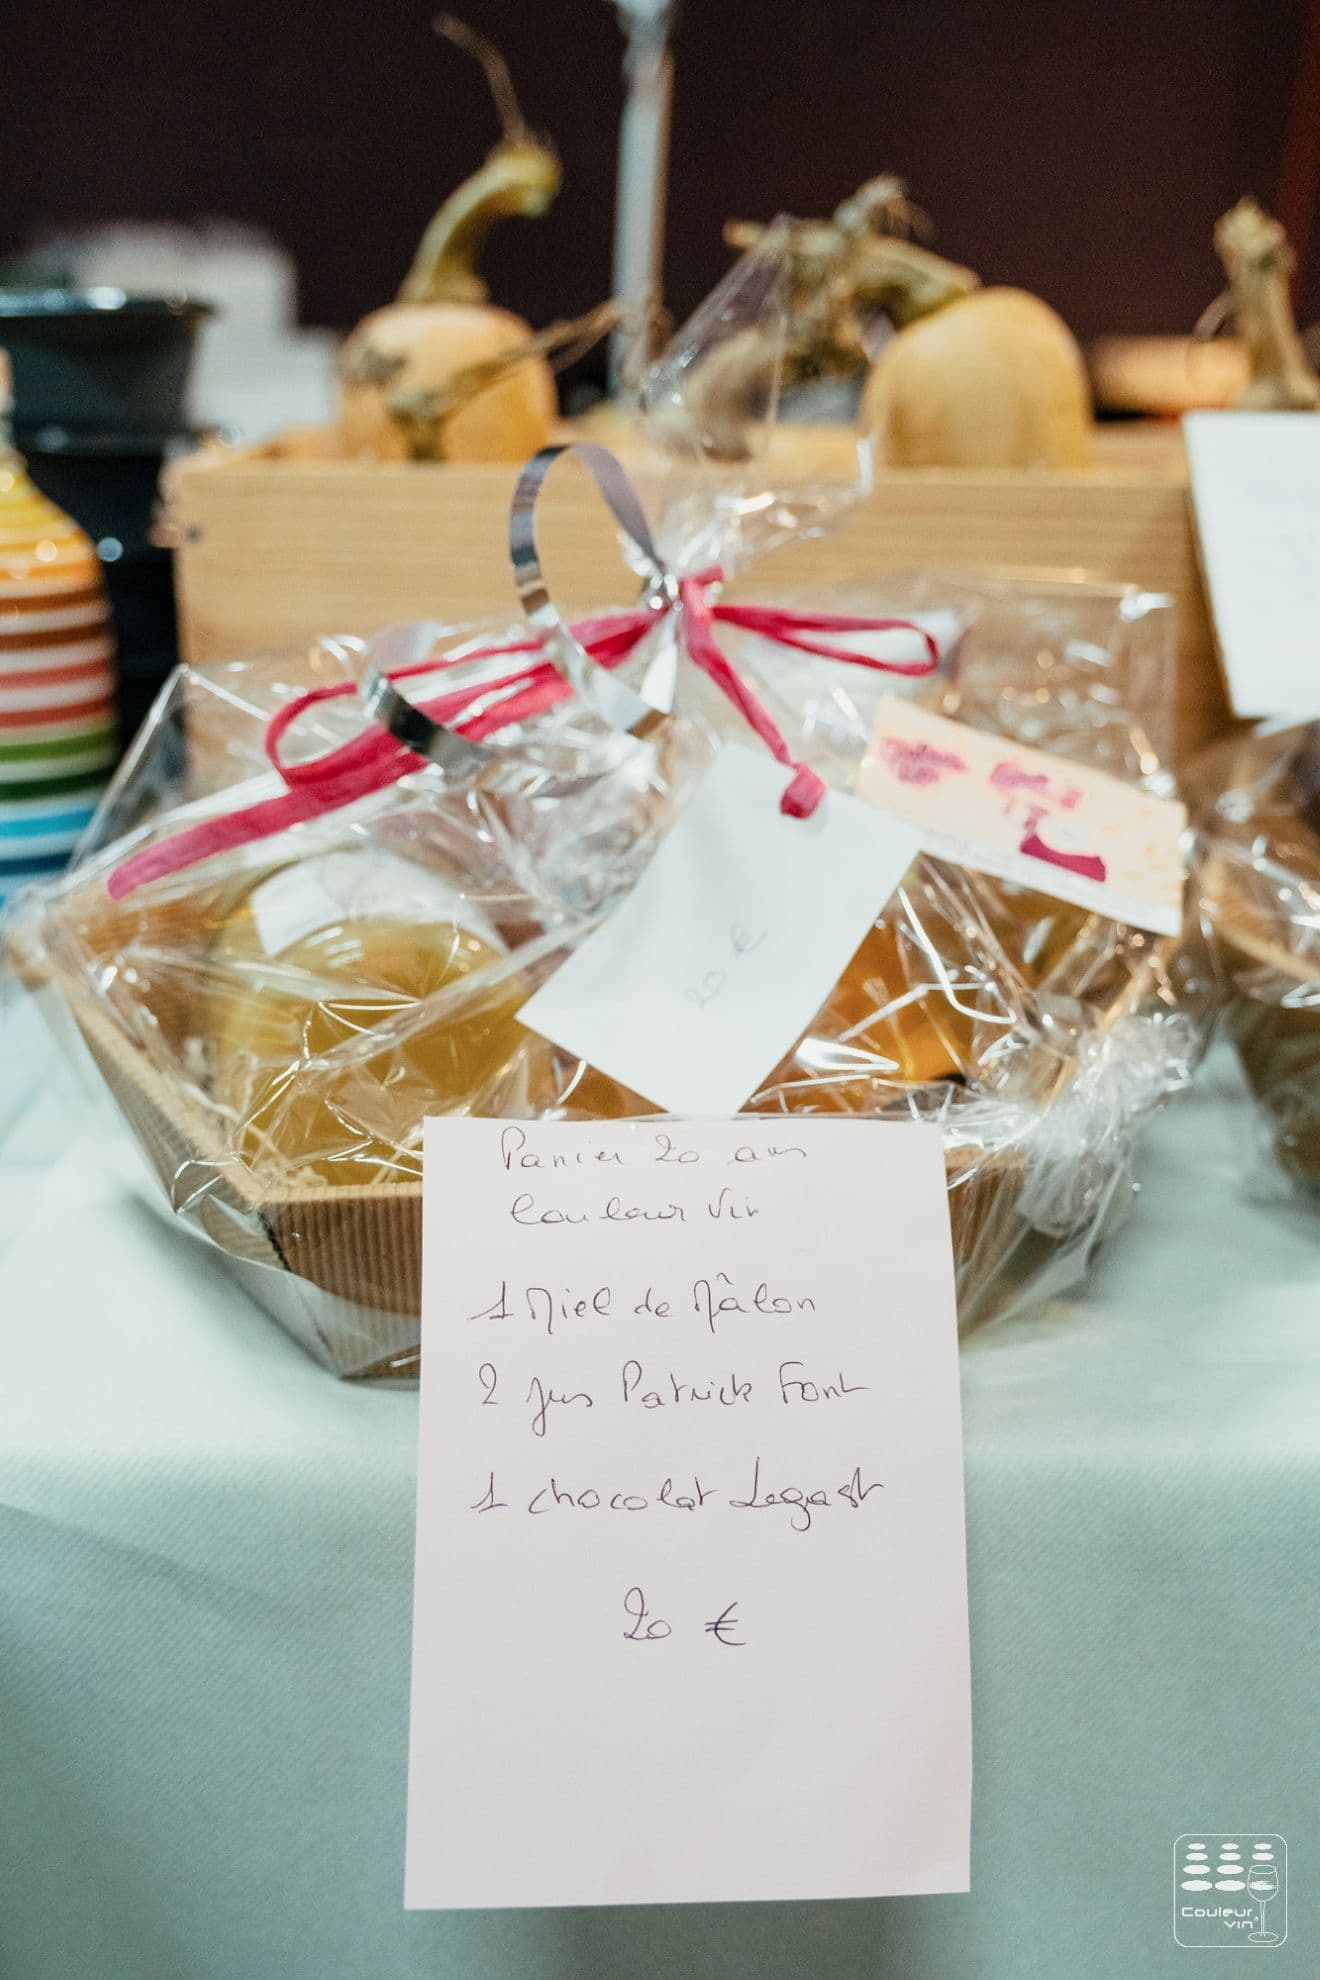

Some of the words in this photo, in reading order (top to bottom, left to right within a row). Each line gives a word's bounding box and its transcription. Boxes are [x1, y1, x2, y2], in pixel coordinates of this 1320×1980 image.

[501, 1125, 624, 1171] Panier
[655, 1134, 700, 1164] 20
[467, 1280, 515, 1321] 1
[526, 1286, 612, 1335] Miel
[634, 1287, 671, 1318] de
[478, 1362, 499, 1406] 2
[621, 1359, 753, 1410] Patrick
[779, 1360, 871, 1405] Font
[470, 1471, 509, 1515] 1
[623, 1586, 673, 1641] 20
[703, 1601, 748, 1647] €
